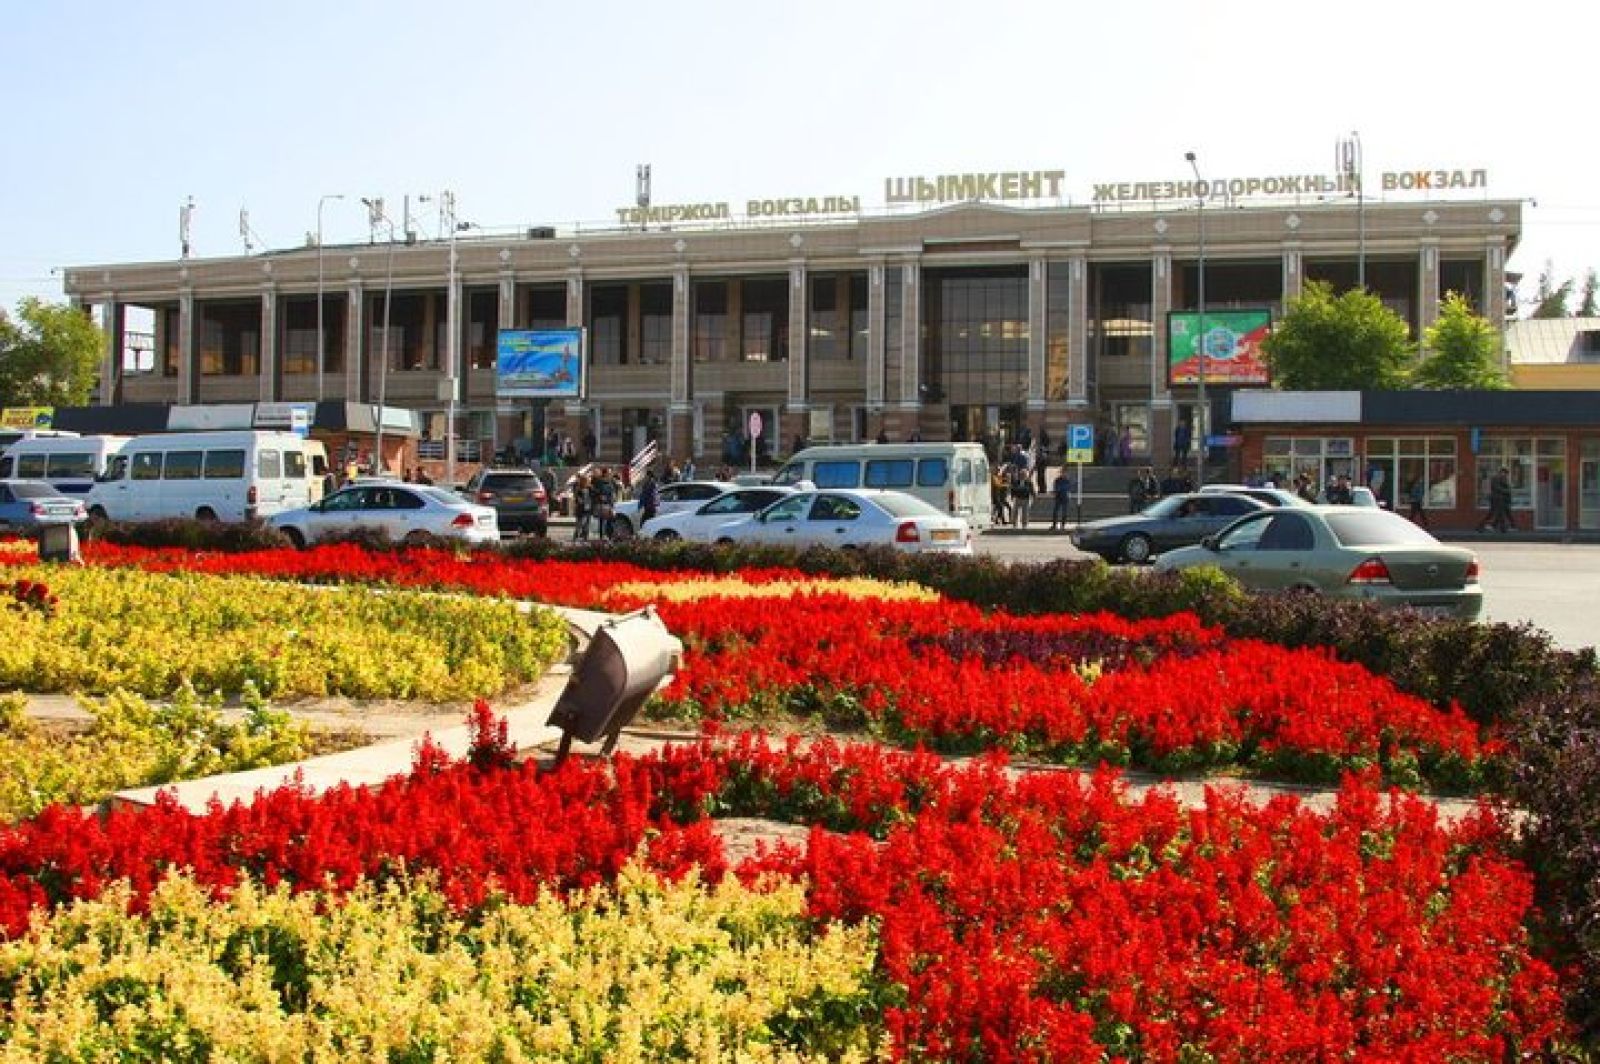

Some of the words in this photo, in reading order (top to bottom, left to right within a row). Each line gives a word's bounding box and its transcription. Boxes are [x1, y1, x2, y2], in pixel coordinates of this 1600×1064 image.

[886, 170, 1065, 202] ШЫМКЕНТ
[1382, 169, 1487, 190] ВОКЗАЛ
[746, 195, 859, 216] ВОКЗАЛЫ
